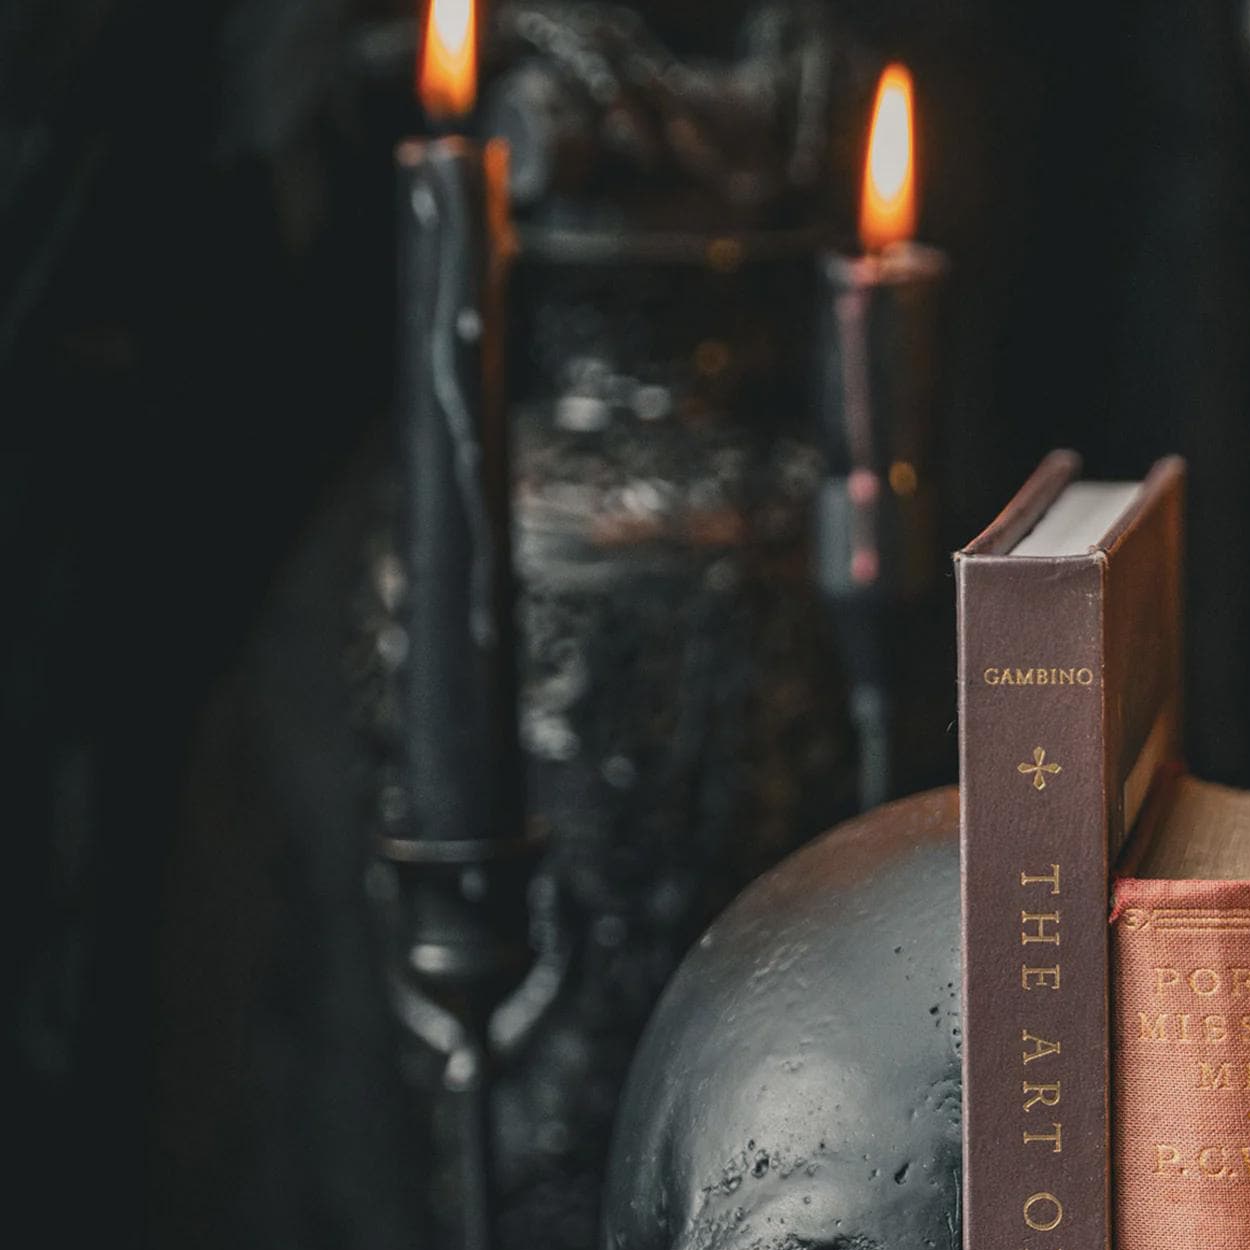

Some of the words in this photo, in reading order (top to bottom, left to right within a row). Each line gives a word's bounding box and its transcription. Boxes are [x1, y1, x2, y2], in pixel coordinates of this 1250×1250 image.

[983, 667, 1094, 687] GAMBINO
[1020, 864, 1061, 991] THE
[1021, 1029, 1062, 1153] ART
